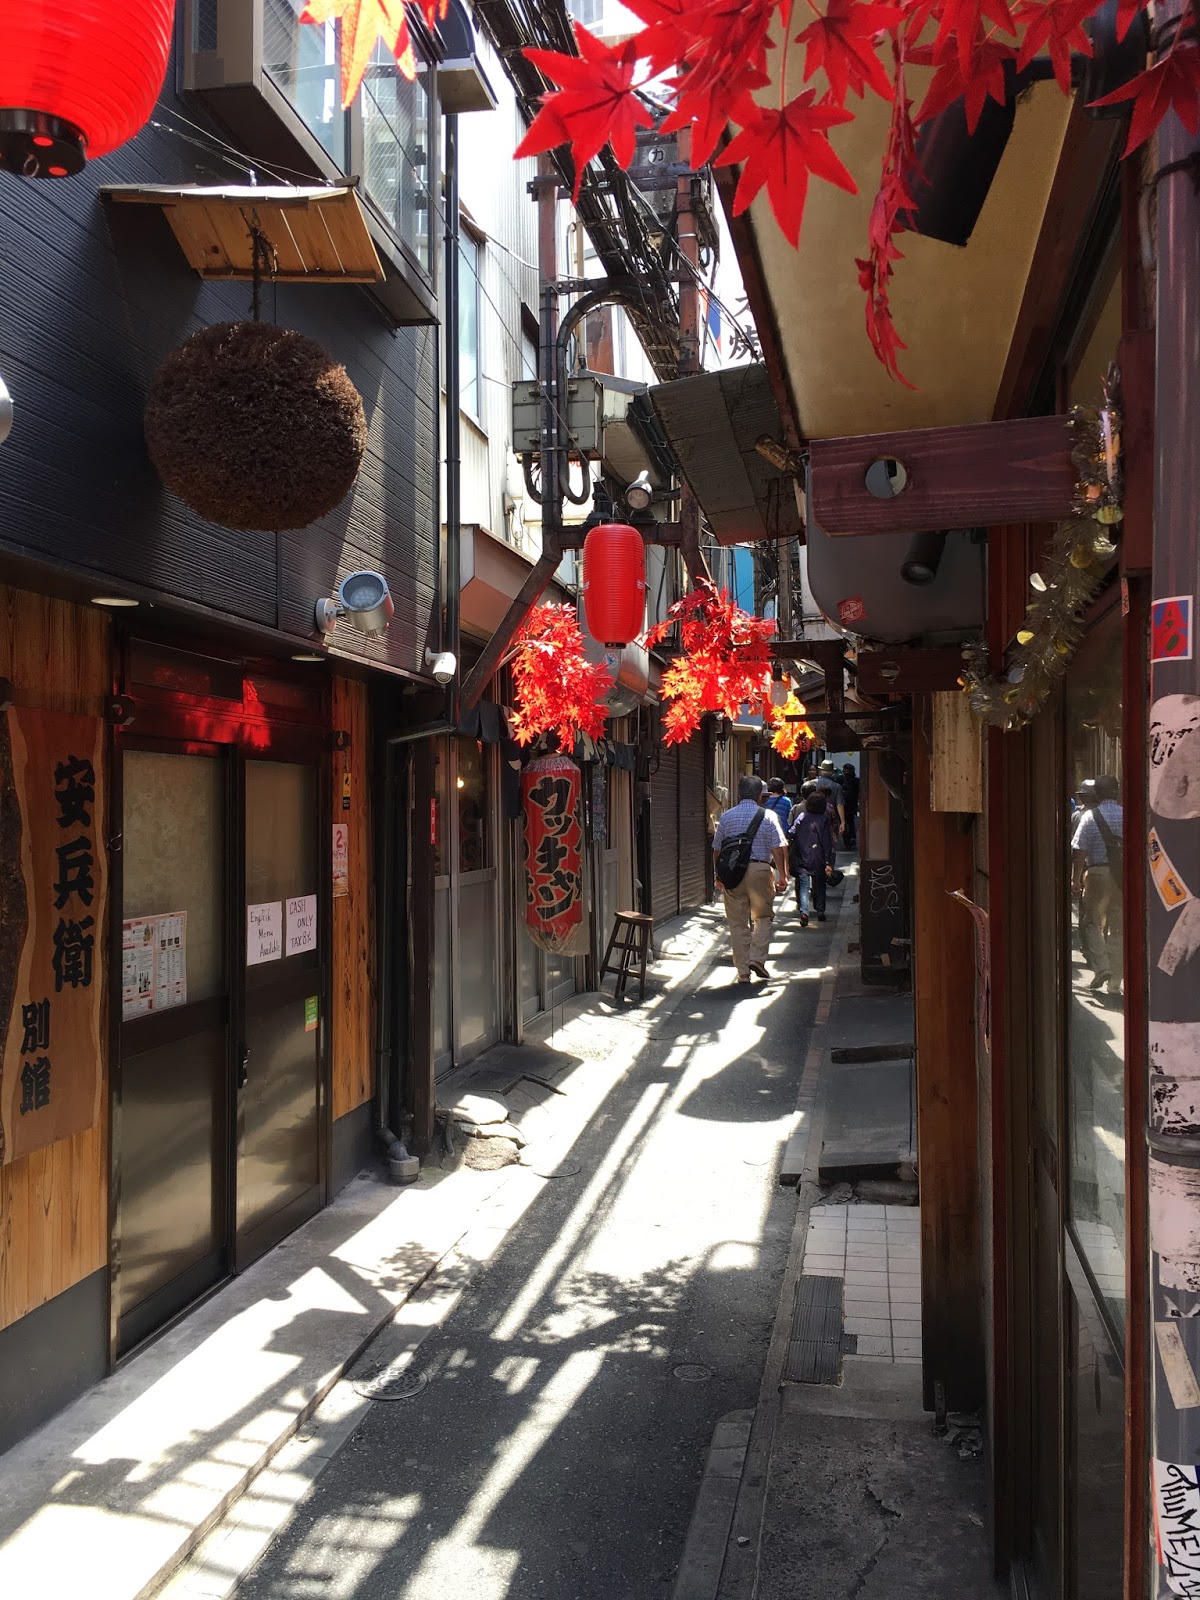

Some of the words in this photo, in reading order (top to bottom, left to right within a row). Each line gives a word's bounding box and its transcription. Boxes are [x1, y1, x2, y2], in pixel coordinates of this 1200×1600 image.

[527, 776, 573, 921] カッチャン
[53, 754, 96, 993] 安兵衛
[289, 899, 306, 915] CASH
[250, 908, 271, 926] English
[296, 915, 314, 928] ONLY
[258, 929, 274, 940] Menu
[259, 940, 280, 957] Available
[20, 998, 51, 1115] 別館
